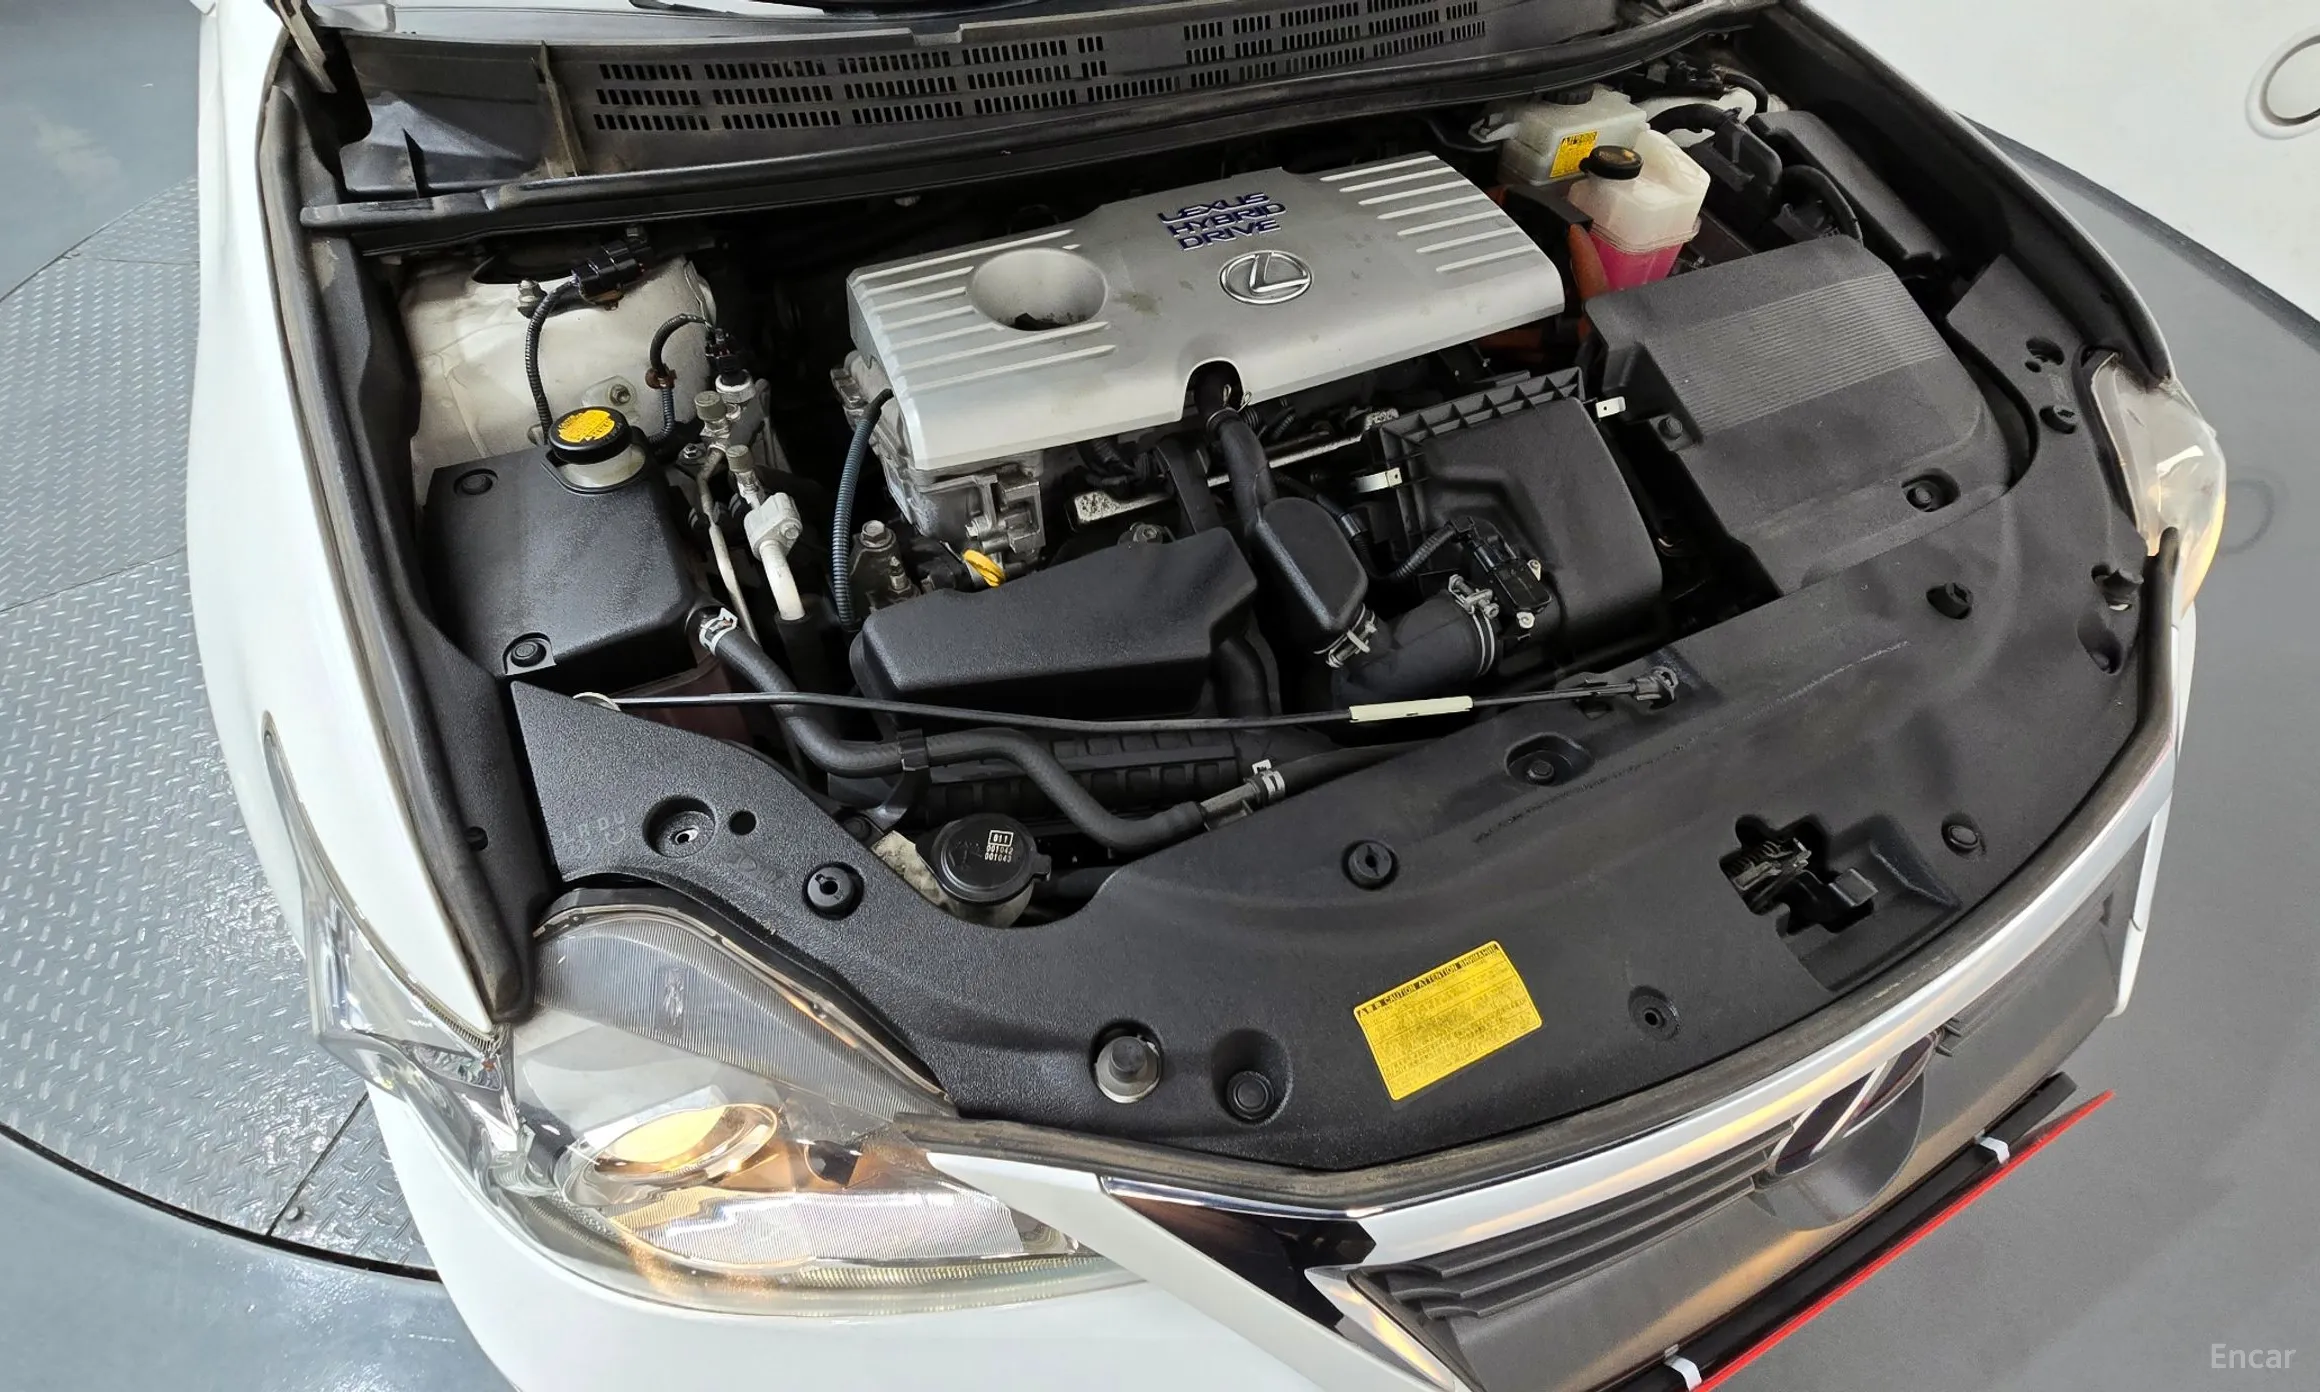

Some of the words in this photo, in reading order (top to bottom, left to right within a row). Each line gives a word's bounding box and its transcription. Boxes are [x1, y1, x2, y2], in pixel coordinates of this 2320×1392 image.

[1157, 192, 1270, 223] LEXUS
[1167, 203, 1287, 237] HYBRID
[1178, 219, 1281, 250] DRIVE
